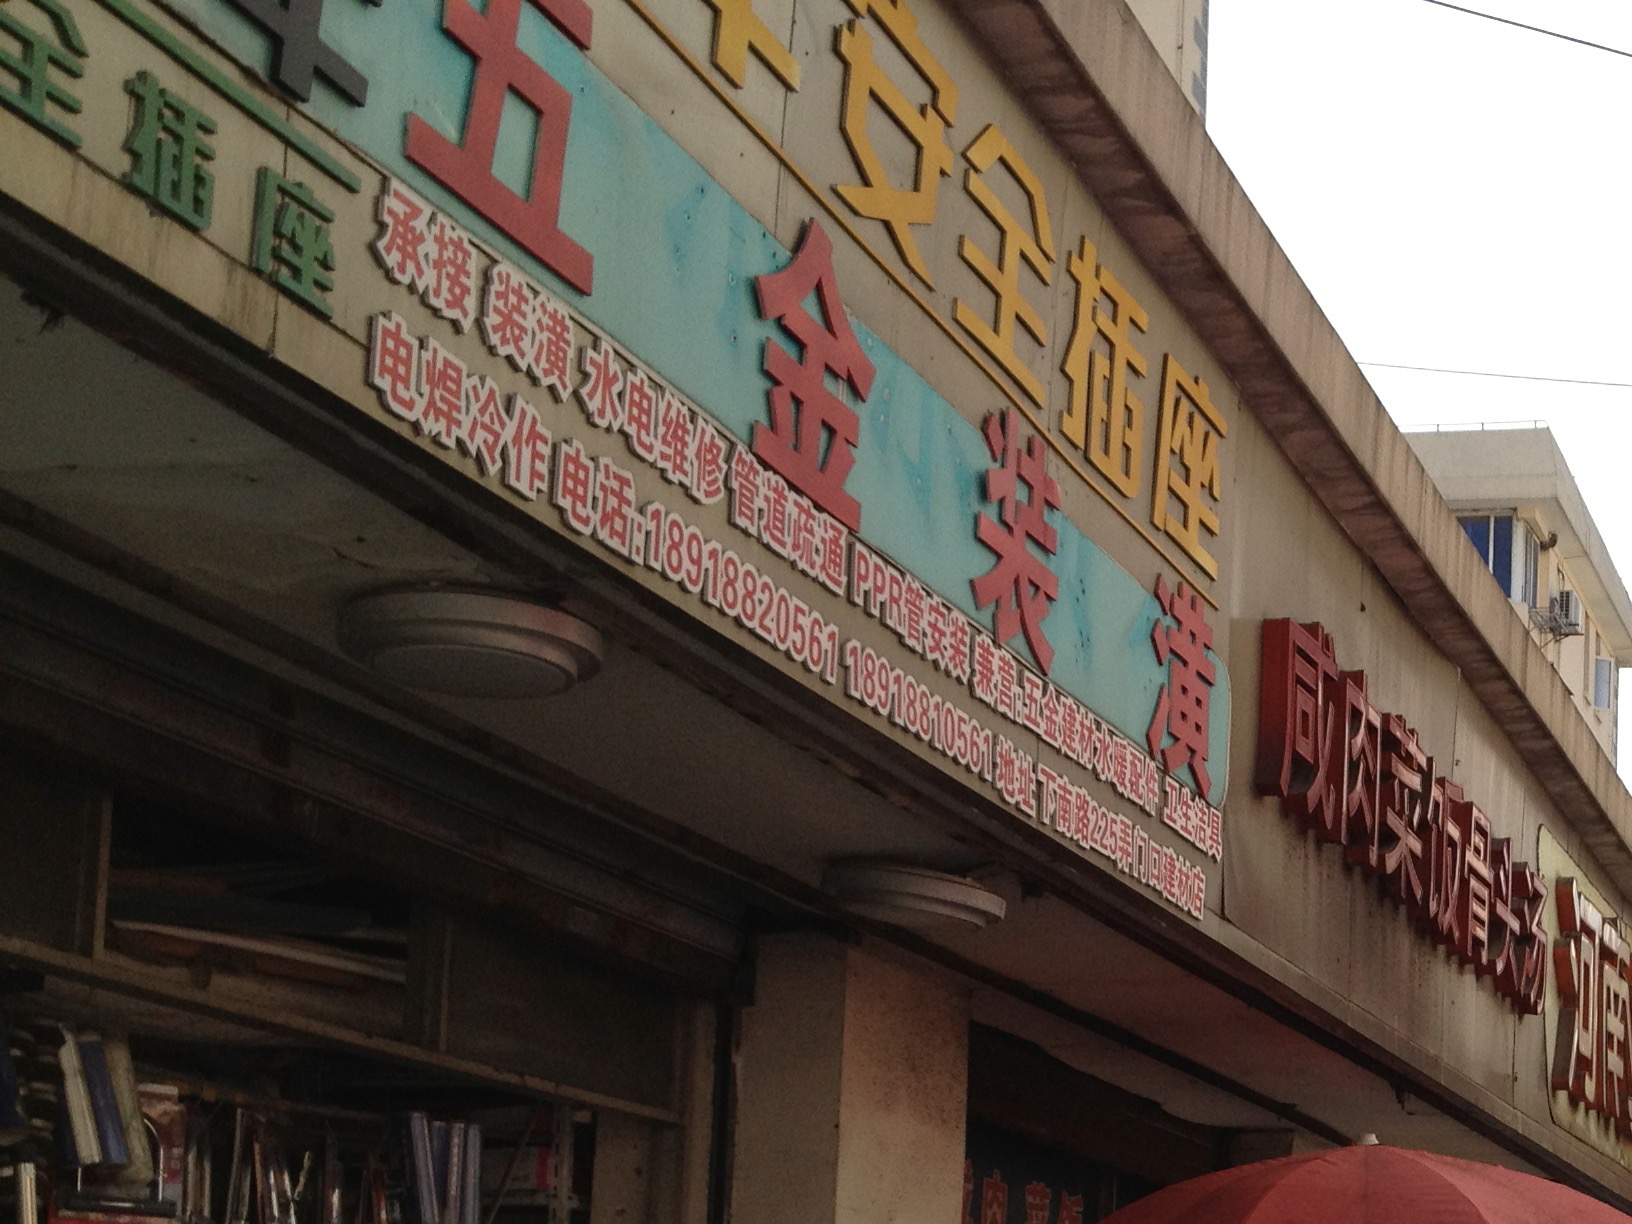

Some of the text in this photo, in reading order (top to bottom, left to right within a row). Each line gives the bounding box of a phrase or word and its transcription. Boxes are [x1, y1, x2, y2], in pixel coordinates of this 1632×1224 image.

[374, 313, 551, 499] 电焊冷作
[847, 640, 991, 781] 18918810561
[381, 183, 475, 330] 承接
[487, 264, 573, 400] 装潢
[583, 343, 727, 503] 水电维修
[731, 445, 848, 597] 管道疏通
[855, 545, 970, 683] PPR管安装
[1164, 778, 1222, 862] 卫生洁具
